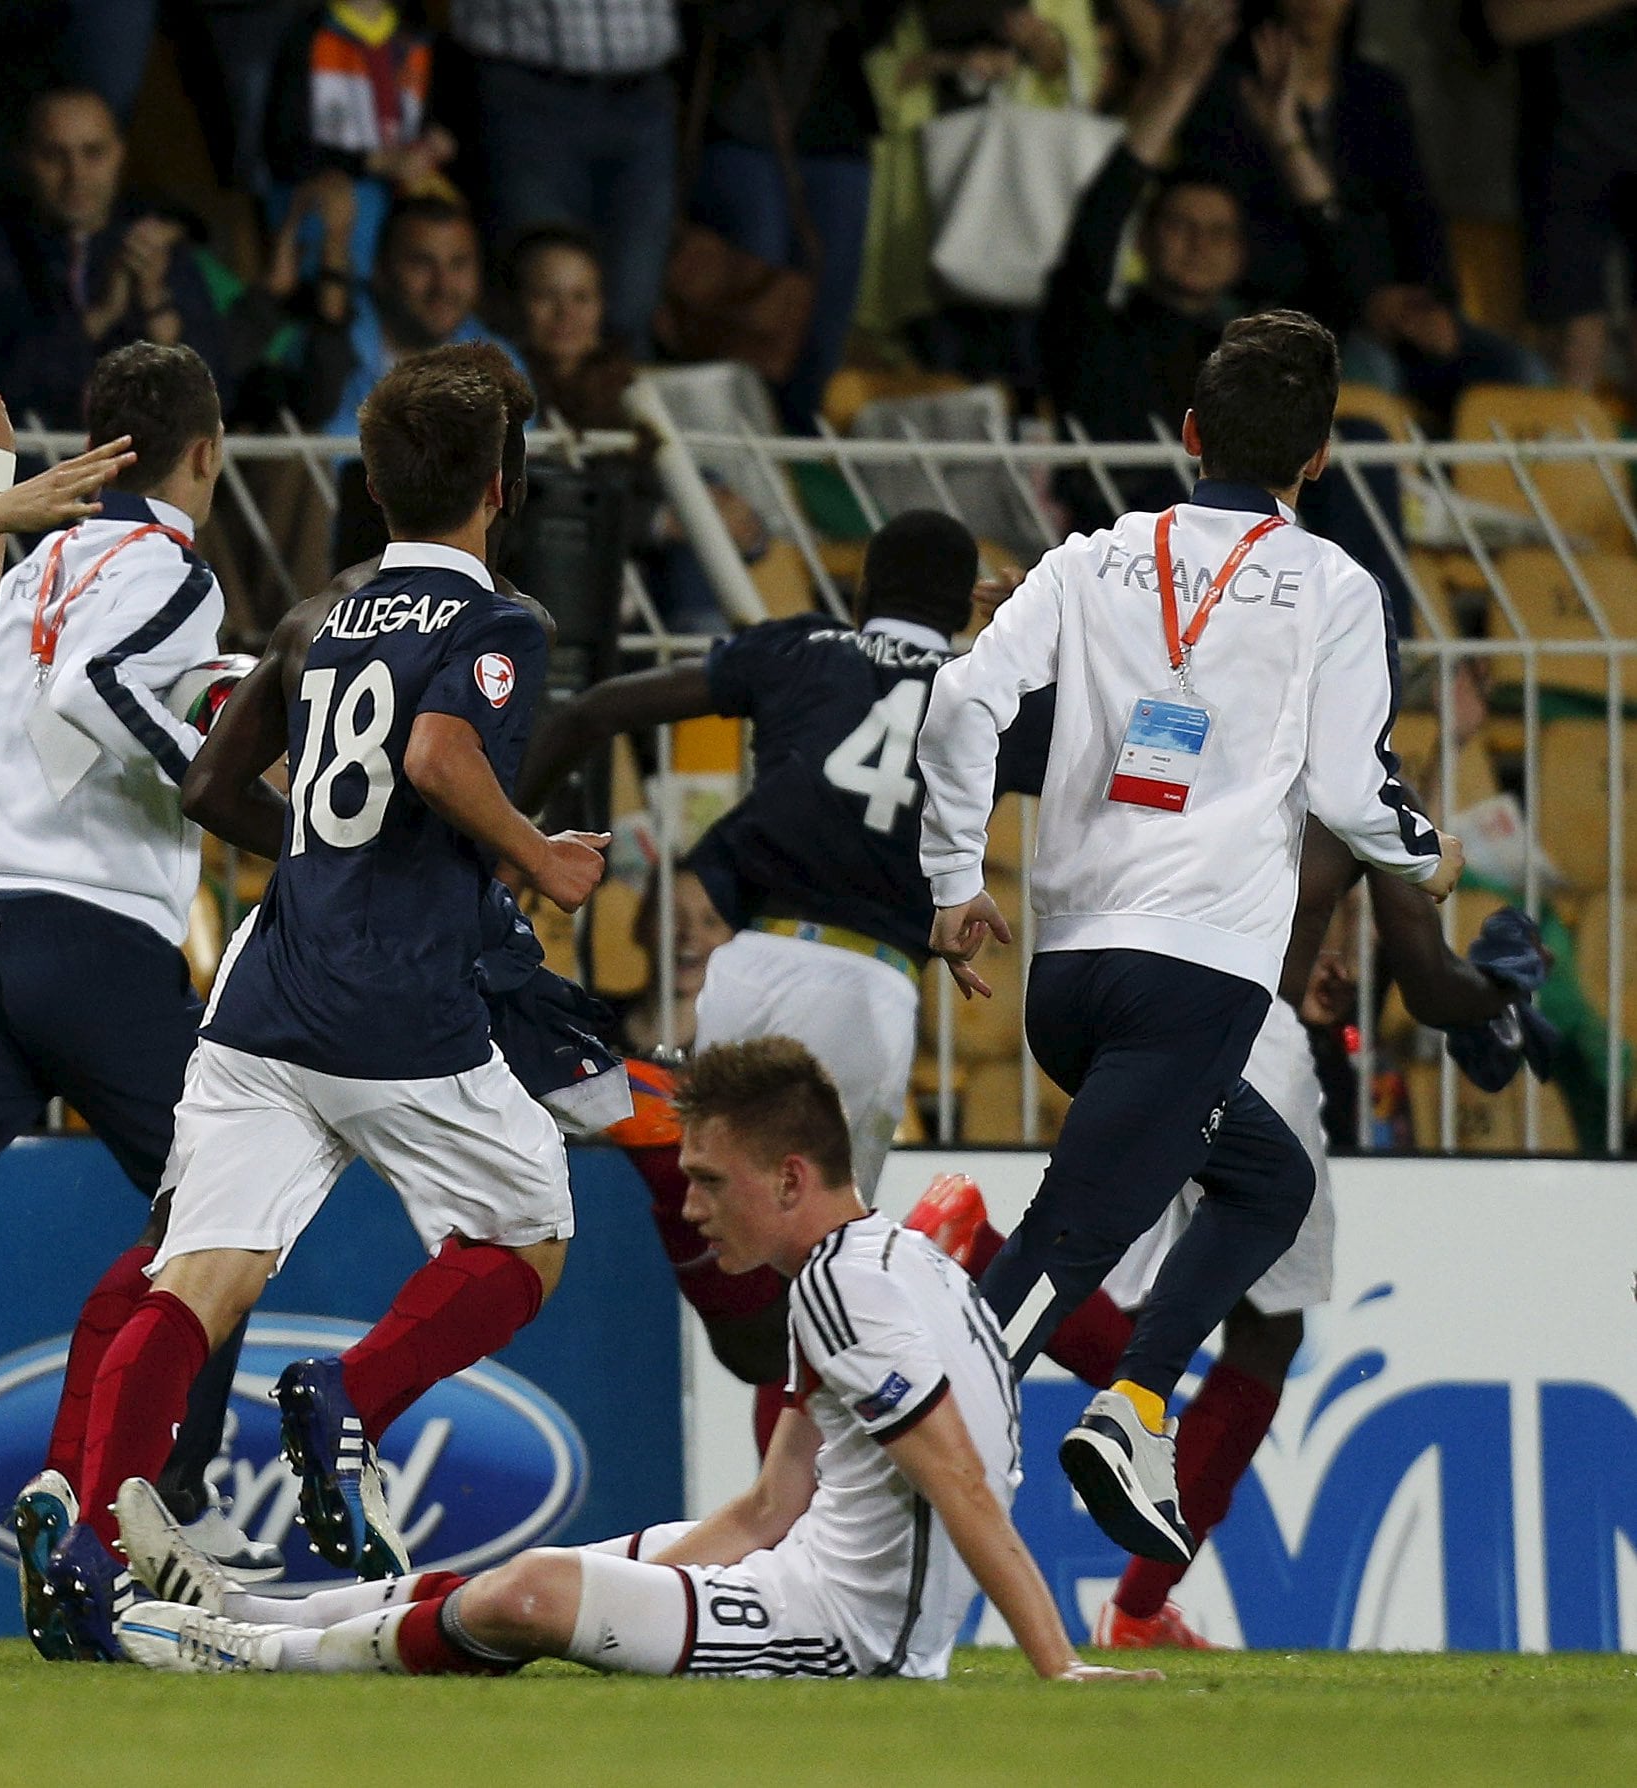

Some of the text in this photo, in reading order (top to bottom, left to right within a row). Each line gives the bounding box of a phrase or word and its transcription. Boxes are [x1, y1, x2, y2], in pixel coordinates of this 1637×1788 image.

[1096, 544, 1304, 609] FRANCE
[312, 593, 471, 643] ALLEGAR
[288, 658, 396, 858] 18
[822, 677, 928, 833] 4
[704, 1579, 770, 1629] 18
